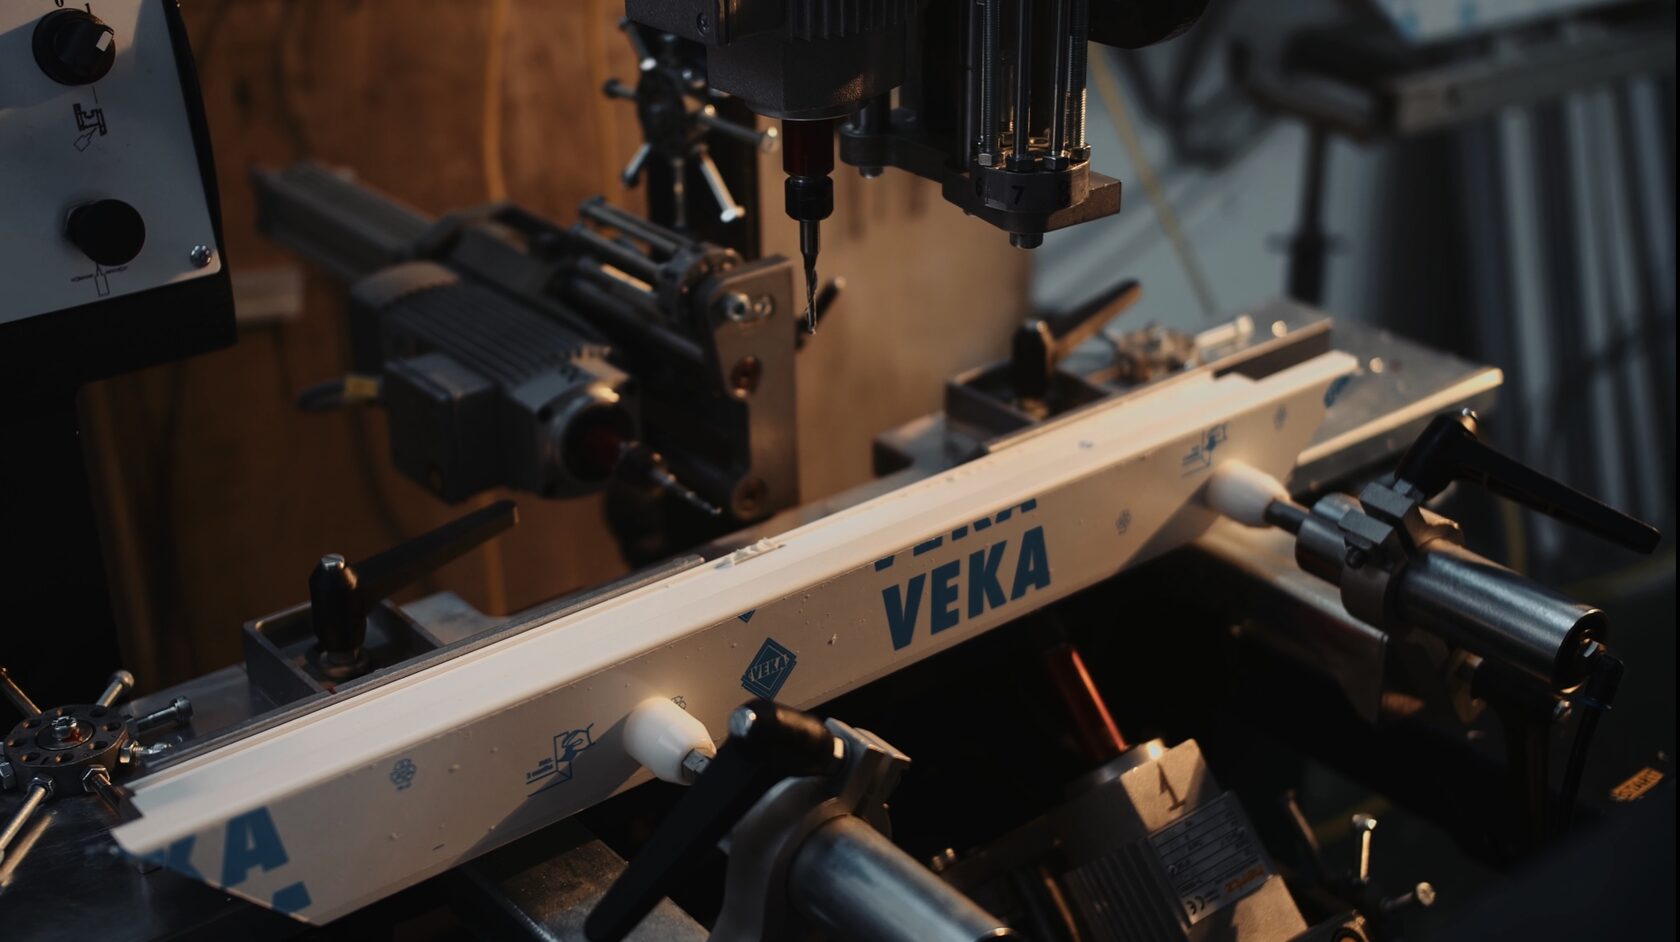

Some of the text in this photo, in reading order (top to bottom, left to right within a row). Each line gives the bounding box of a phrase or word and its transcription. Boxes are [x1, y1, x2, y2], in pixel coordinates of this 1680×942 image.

[1011, 185, 1025, 205] 7
[882, 525, 1051, 651] VEKA
[748, 653, 790, 683] VEKA
[1157, 763, 1186, 811] 1
[136, 806, 289, 888] KA
